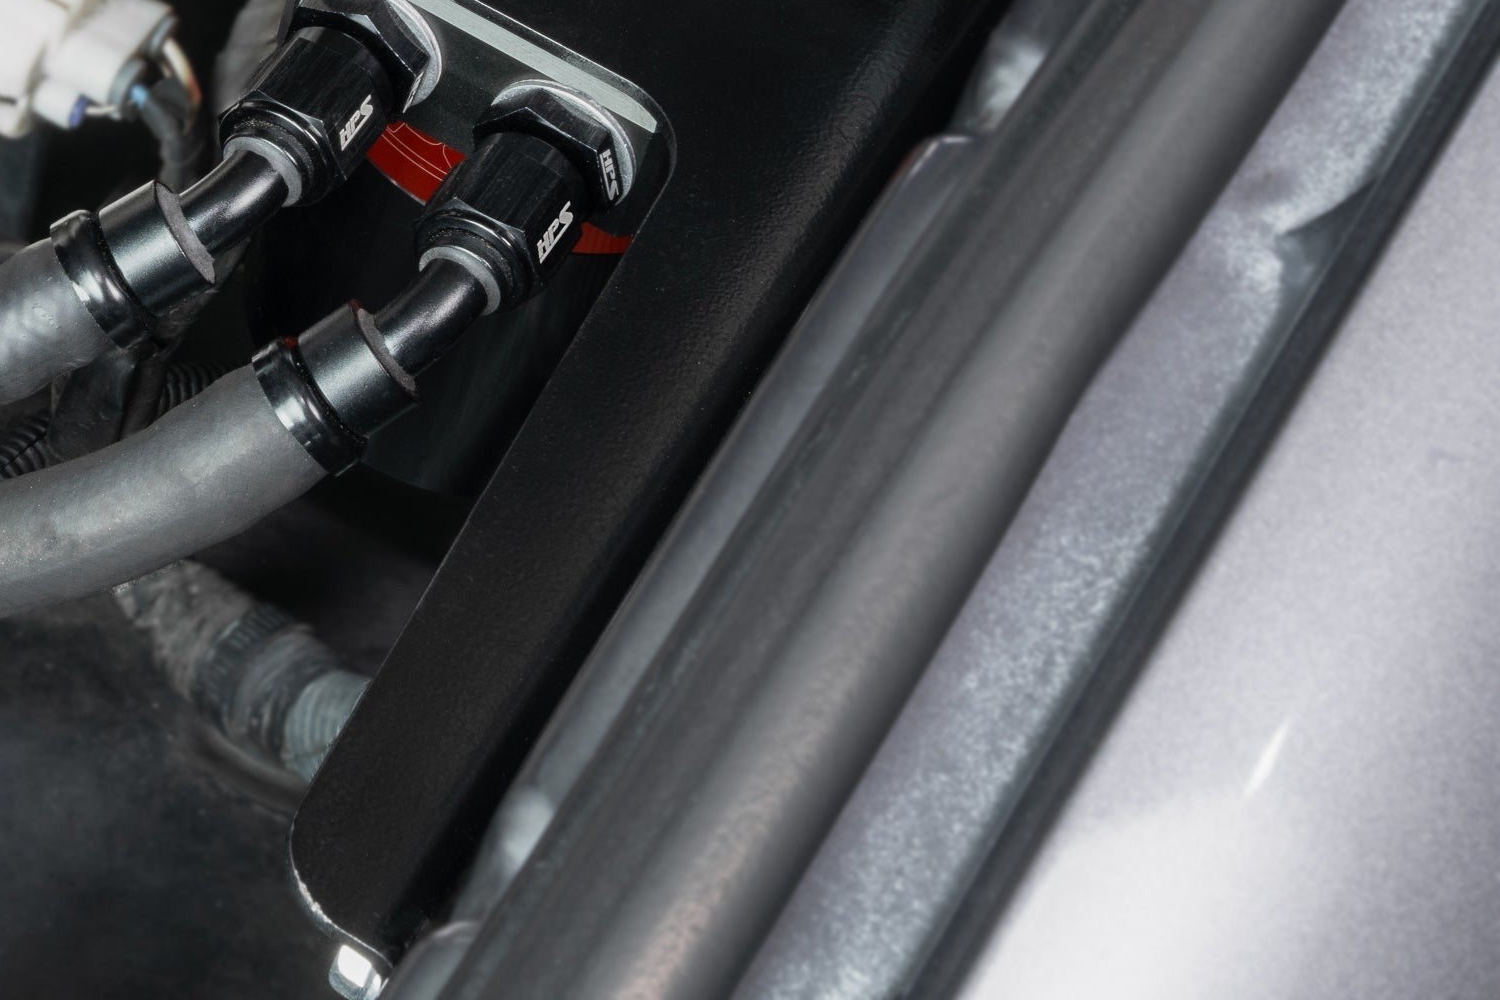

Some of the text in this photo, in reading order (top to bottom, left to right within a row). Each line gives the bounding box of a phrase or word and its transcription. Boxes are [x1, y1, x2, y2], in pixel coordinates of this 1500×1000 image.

[339, 94, 374, 152] HPS
[600, 148, 620, 200] HPS
[537, 200, 574, 264] HPS
